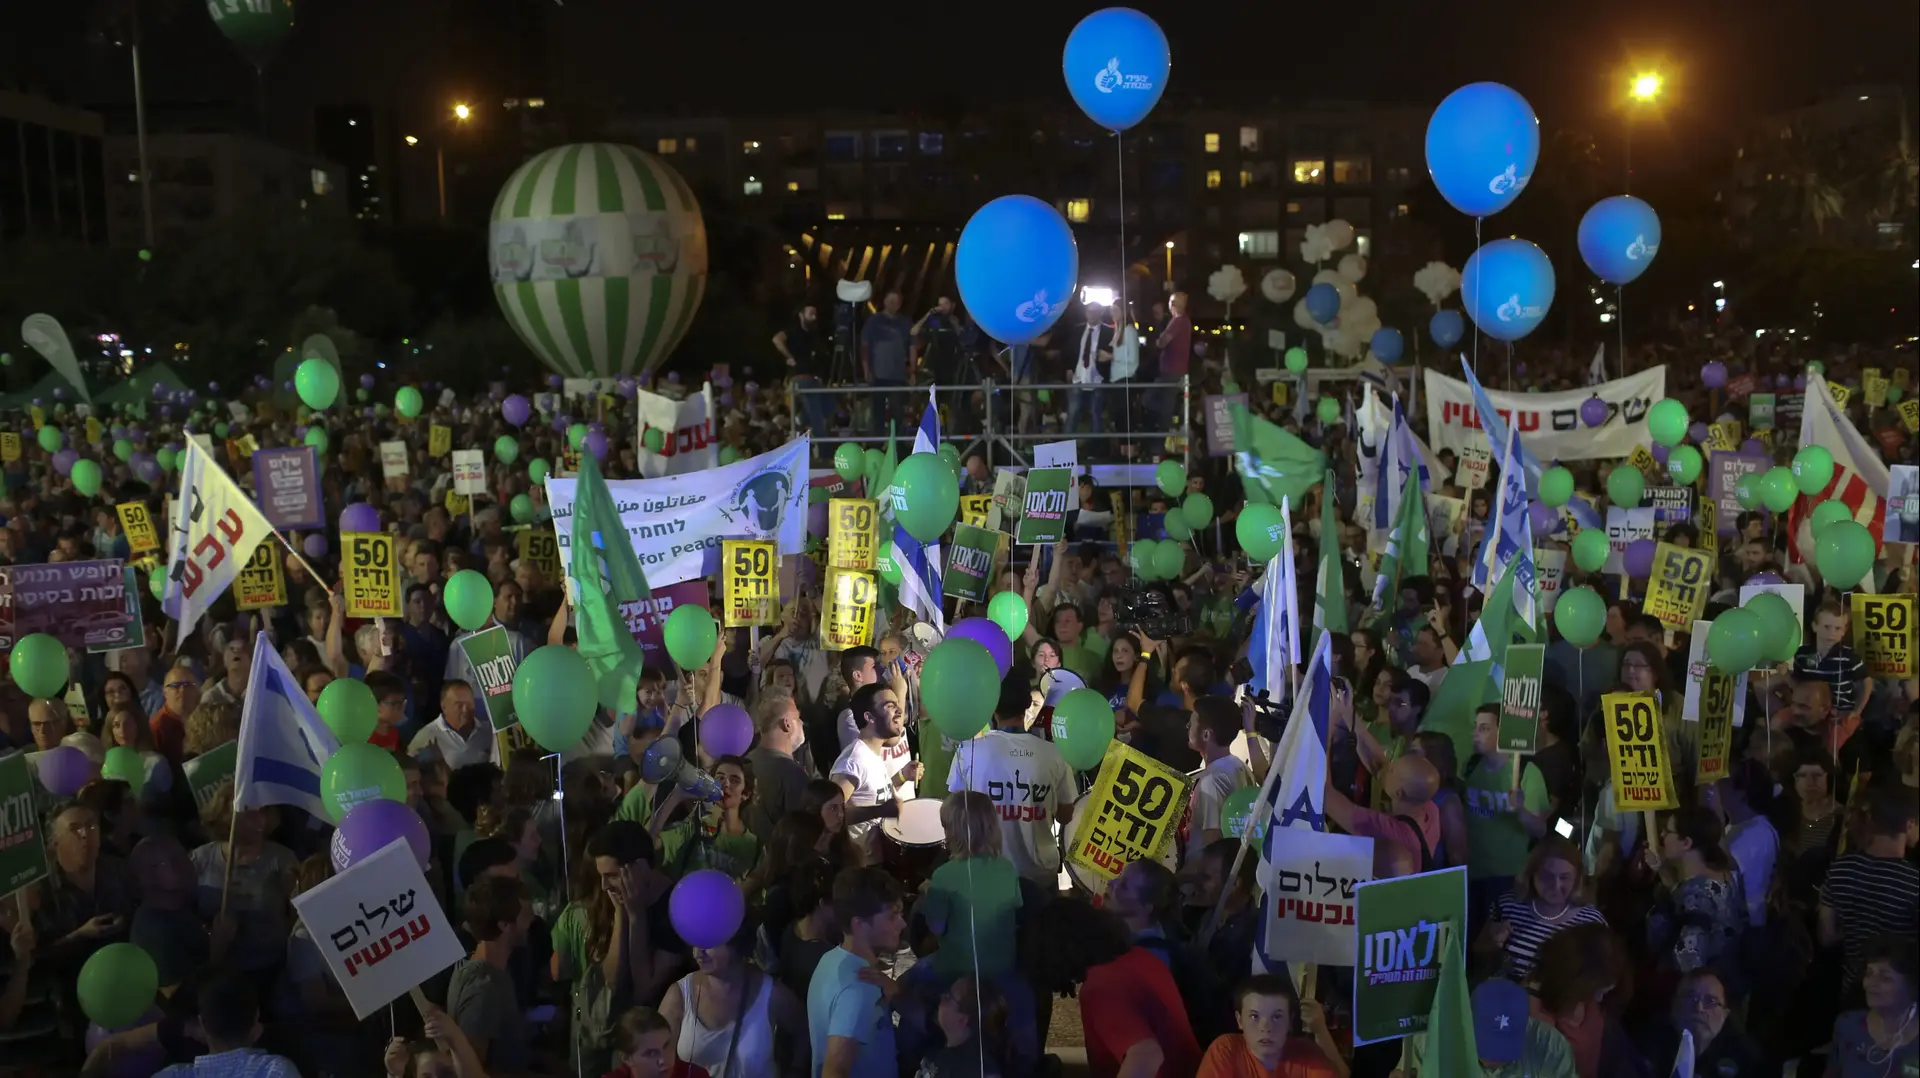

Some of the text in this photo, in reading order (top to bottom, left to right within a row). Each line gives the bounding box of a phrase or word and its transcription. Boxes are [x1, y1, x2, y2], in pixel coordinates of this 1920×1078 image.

[1831, 386, 1846, 402] 50
[1551, 397, 1651, 431] שלם
[1463, 444, 1489, 459] שלום
[890, 495, 909, 511] מר
[123, 507, 145, 523] 50
[840, 505, 871, 531] 50
[626, 518, 686, 541] לוחמי
[1609, 520, 1651, 538] שלום
[354, 538, 389, 567] 50
[528, 536, 554, 558] 50
[639, 535, 724, 567] for Peace
[735, 548, 769, 576] 50
[1663, 551, 1703, 584] 50
[15, 564, 121, 585] חופש תנוע
[354, 568, 389, 586] ודי!
[16, 589, 74, 605] בסיסי
[81, 585, 125, 601] זכות
[354, 580, 391, 598] שלום
[734, 578, 769, 595] ודי!
[355, 599, 391, 610] עכשיו
[734, 608, 769, 620] שיו
[1654, 595, 1692, 614] שלום
[829, 621, 864, 635] שלום
[1865, 602, 1907, 631] 50
[1707, 675, 1731, 715] 50
[1615, 702, 1653, 742] 50
[1019, 749, 1034, 757] Like
[1619, 744, 1658, 767] ודי!
[1702, 741, 1724, 758] לום
[988, 769, 1051, 803] שלום
[1622, 763, 1659, 786] שלום
[1112, 758, 1174, 820] 50
[1623, 787, 1661, 801] עכשיו
[0, 791, 34, 836] חלא
[995, 803, 1047, 822] עכשי
[1097, 799, 1158, 850] ודי!
[1089, 826, 1145, 863] שלום
[1082, 841, 1125, 875] כשיו
[1279, 861, 1366, 899] שלום
[331, 889, 416, 952] שלום
[343, 914, 431, 977] עכשיו
